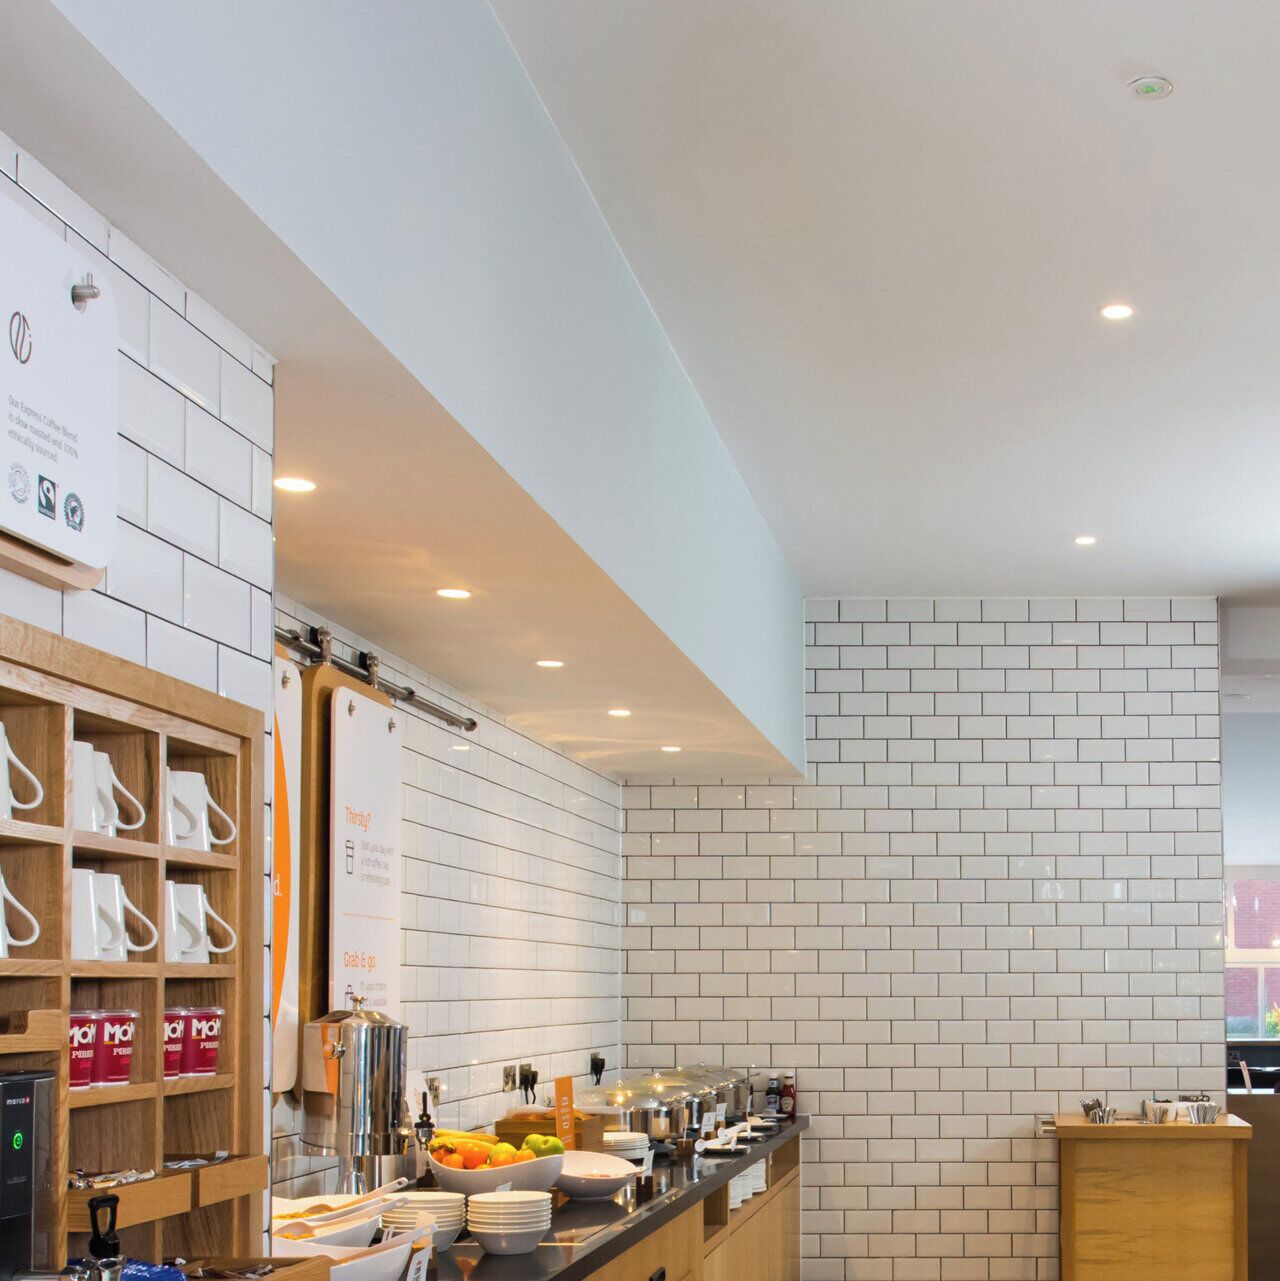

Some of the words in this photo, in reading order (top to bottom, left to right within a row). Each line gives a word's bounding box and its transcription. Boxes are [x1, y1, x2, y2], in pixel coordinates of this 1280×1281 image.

[8, 394, 20, 408] Our
[21, 402, 42, 422] Express
[43, 415, 61, 433] Coffee
[62, 426, 78, 443] Blend
[15, 415, 28, 429] slow
[29, 425, 51, 443] roasted
[51, 437, 62, 450] and
[8, 429, 34, 452] ethically
[344, 951, 359, 968] Grab
